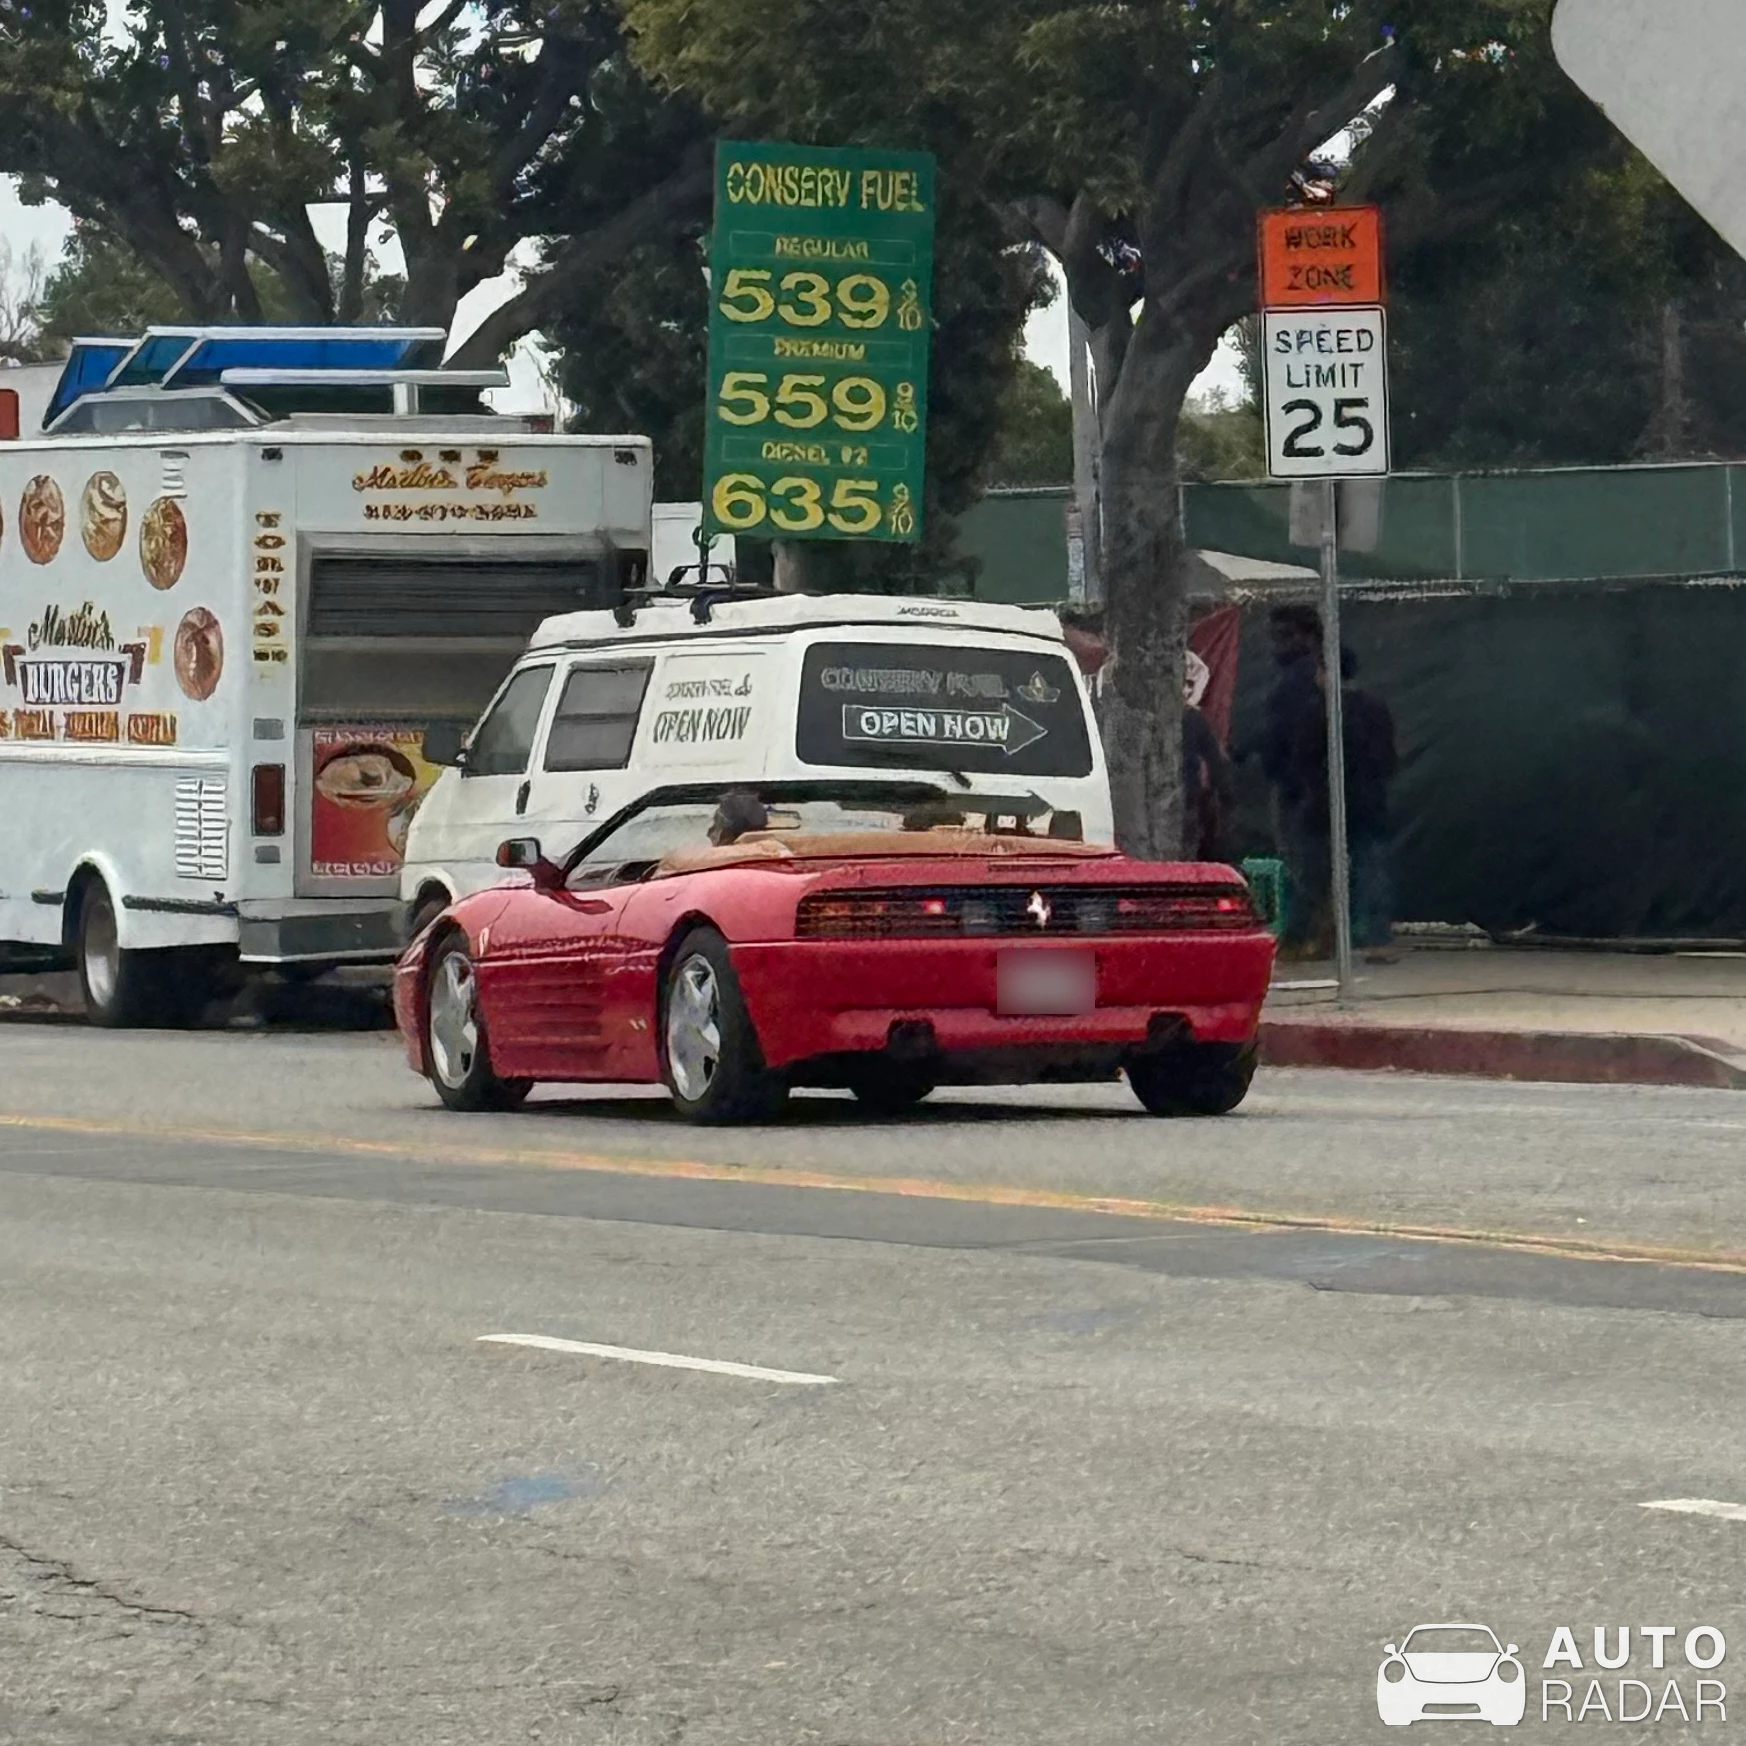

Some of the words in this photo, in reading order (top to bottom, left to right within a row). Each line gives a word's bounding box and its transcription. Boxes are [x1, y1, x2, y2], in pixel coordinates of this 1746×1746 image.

[727, 162, 850, 208] CONSERV
[861, 170, 925, 212] FUEL
[775, 237, 869, 259] REGULAR
[1284, 222, 1358, 250] WORK
[1287, 264, 1356, 290] ZONE
[719, 269, 890, 329] 539
[773, 337, 867, 361] PREMIUM
[1274, 329, 1375, 353] SPEED
[1286, 363, 1364, 388] LIMIT
[717, 371, 886, 431] 559
[1281, 398, 1374, 457] 25
[712, 473, 882, 533] 635
[653, 708, 703, 743] OPEN
[702, 706, 752, 741] NOW
[860, 711, 936, 737] OPEN
[943, 714, 1010, 740] NOW
